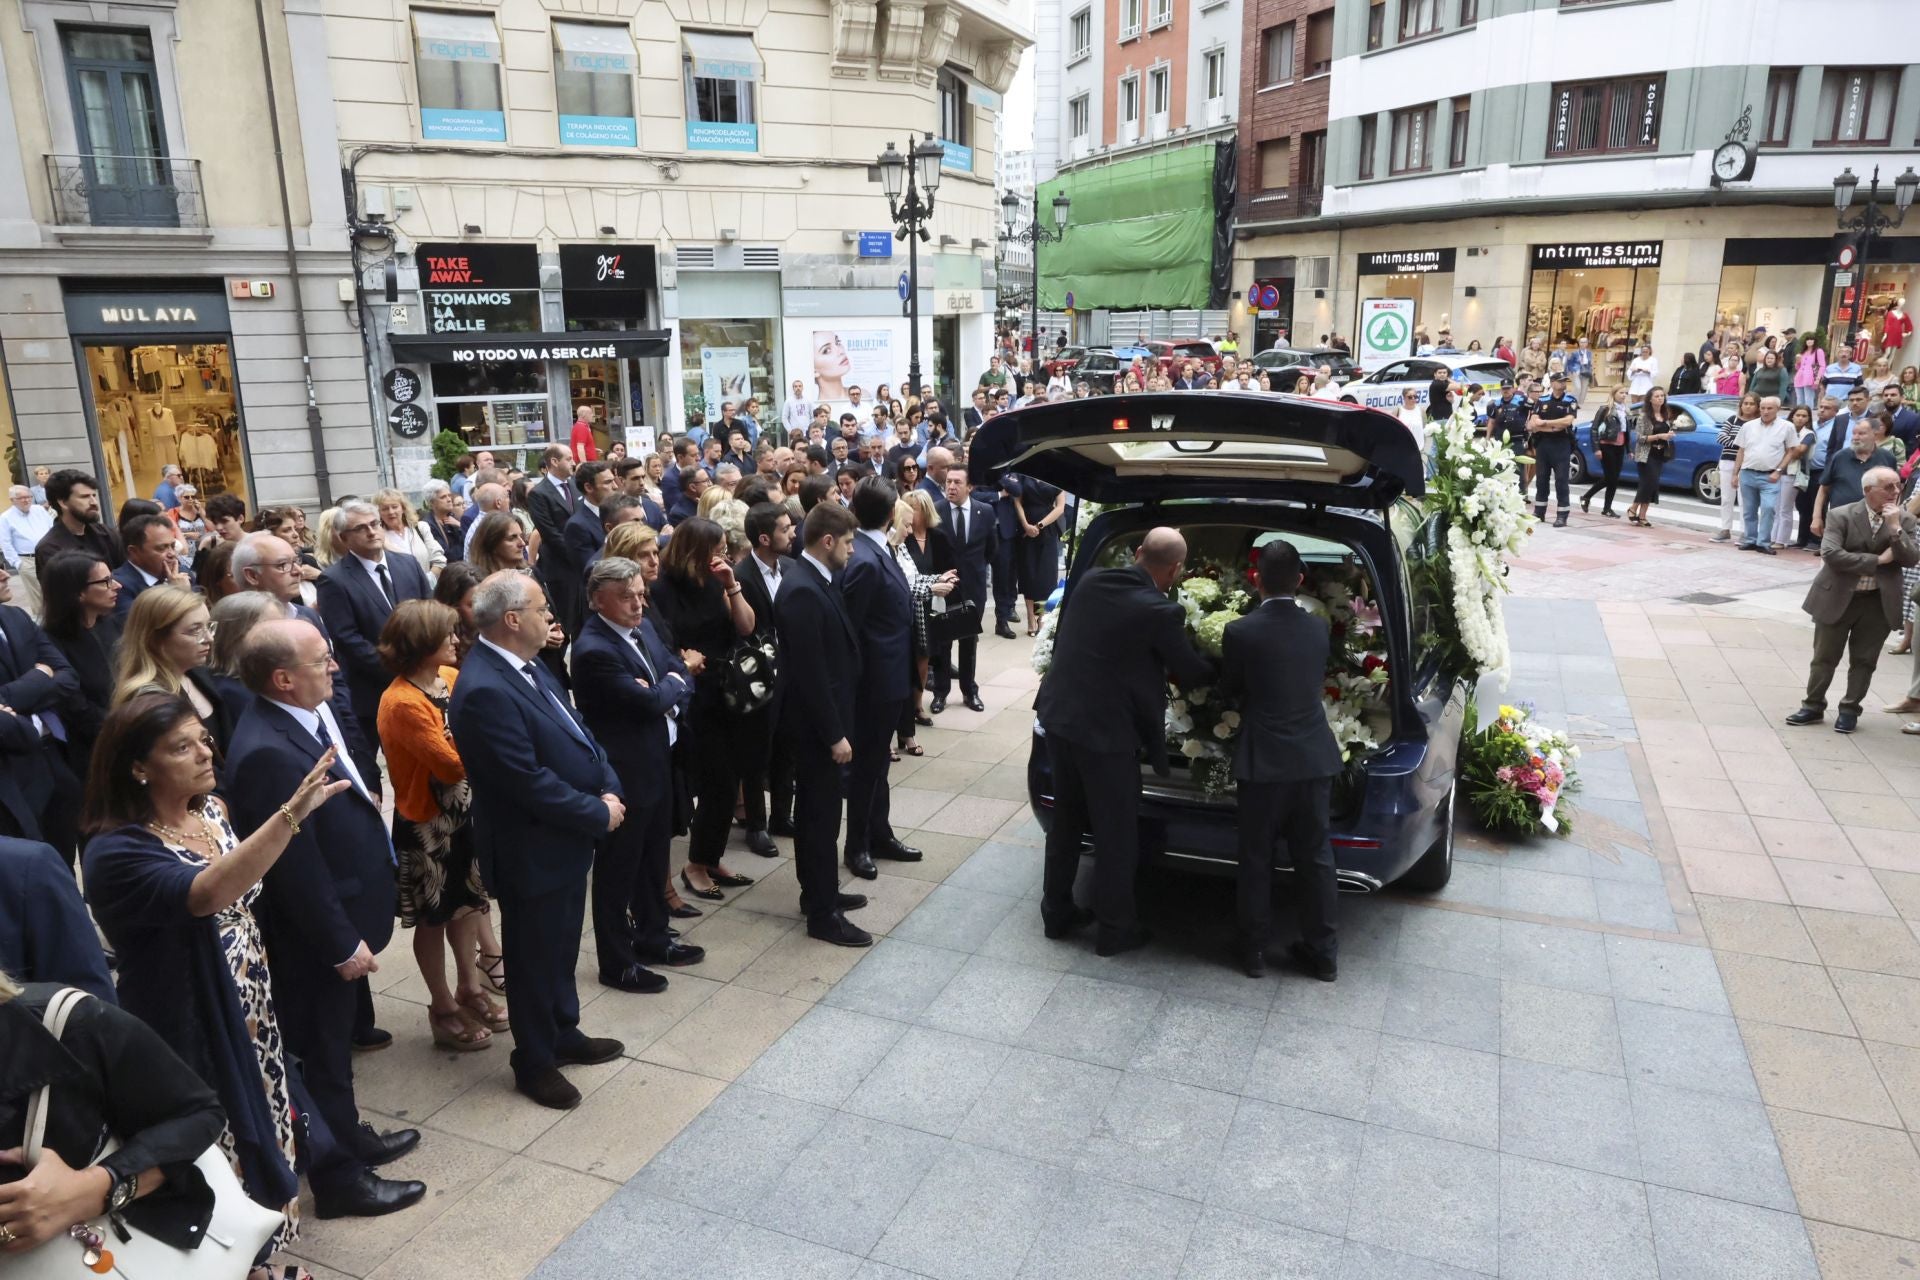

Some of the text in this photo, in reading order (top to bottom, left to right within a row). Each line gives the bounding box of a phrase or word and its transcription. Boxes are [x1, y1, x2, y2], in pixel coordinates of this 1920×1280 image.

[1642, 84, 1656, 141] NOTARIA
[1846, 77, 1861, 136] NOTARIA
[1557, 91, 1570, 147] NOTARIA
[1539, 244, 1660, 258] intimissimi
[427, 257, 469, 270] TAKE
[1371, 251, 1440, 265] intimissimi
[1585, 255, 1658, 266] Italian lingerie
[1397, 263, 1439, 273] Italian lingerie
[431, 293, 512, 305] TOMAMOS
[101, 307, 197, 322] MULAYA
[433, 306, 456, 319] LA
[434, 319, 486, 332] CALLE
[452, 344, 616, 362] NO TODO VA A SER CAFÉ
[1365, 395, 1403, 408] POLICIA
